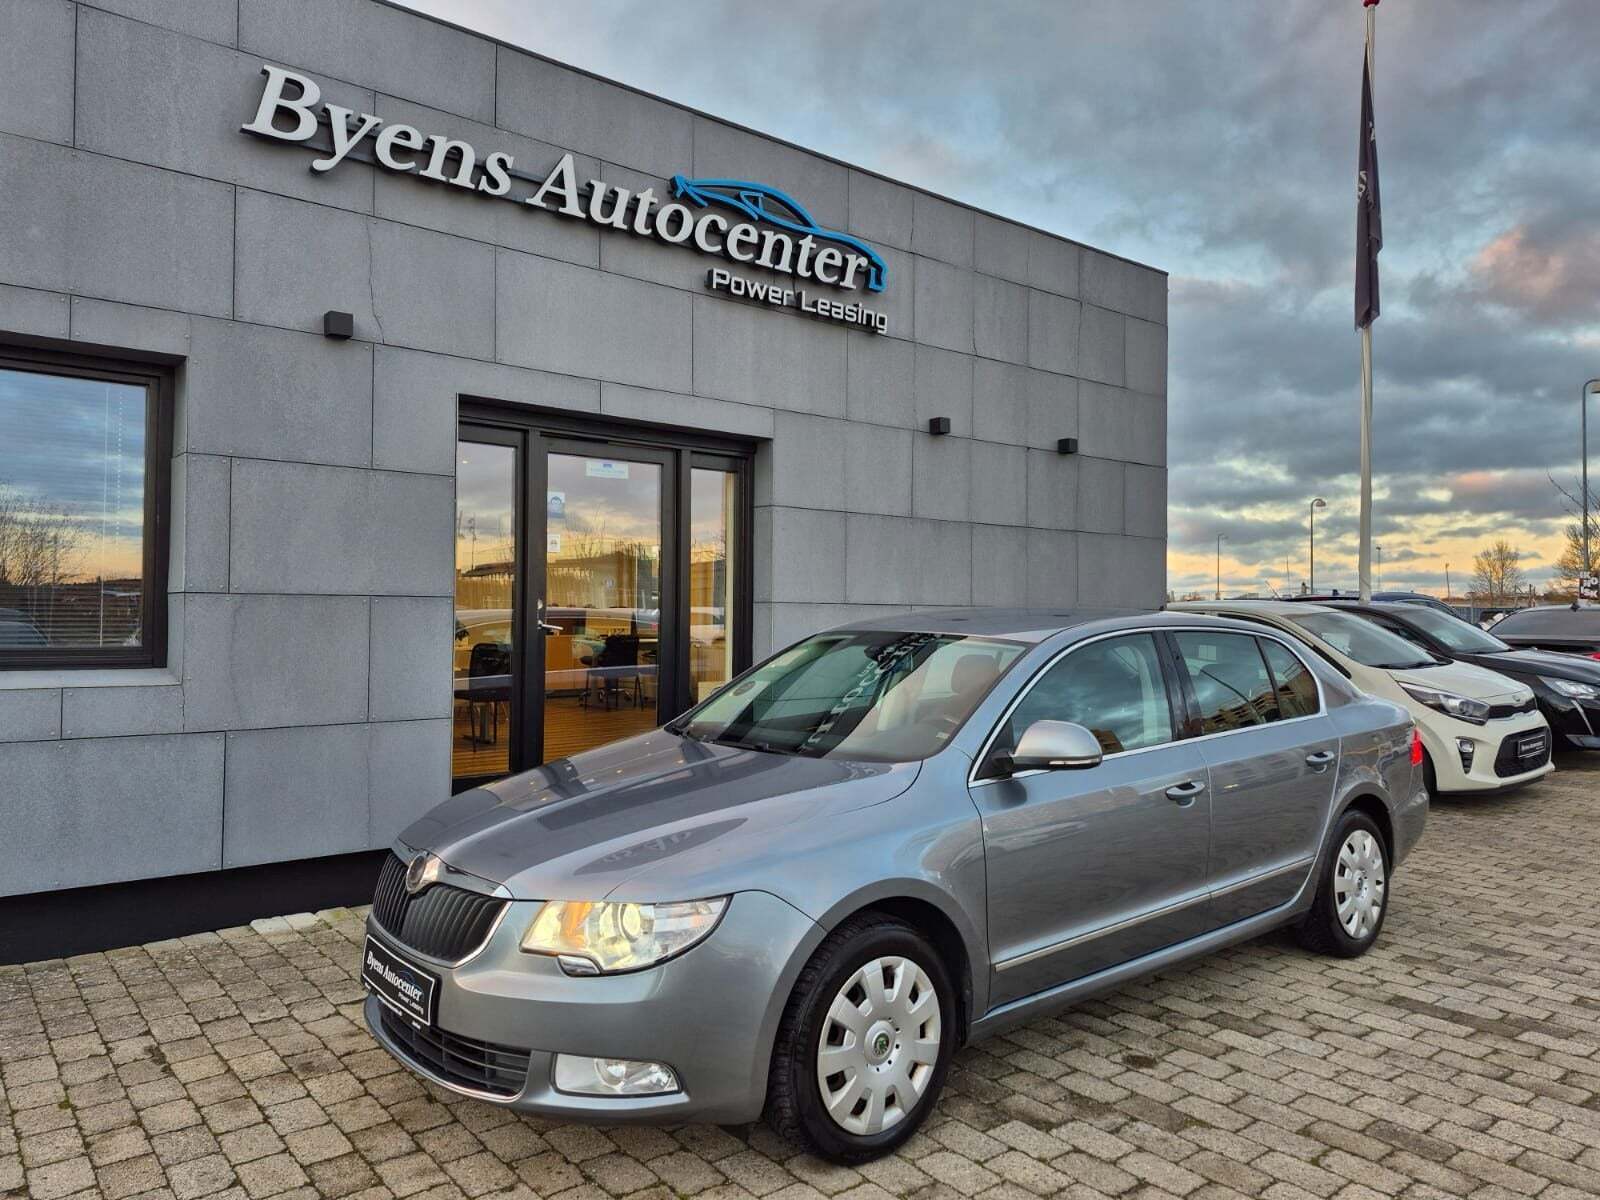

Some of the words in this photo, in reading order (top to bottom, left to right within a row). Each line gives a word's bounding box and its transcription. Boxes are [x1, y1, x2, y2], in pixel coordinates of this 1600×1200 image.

[242, 64, 514, 195] Byens
[525, 153, 867, 290] Autocenter
[712, 268, 794, 306] Power
[801, 290, 888, 334] Leasing
[367, 950, 384, 975] Byens
[383, 965, 422, 1001] Autocenter
